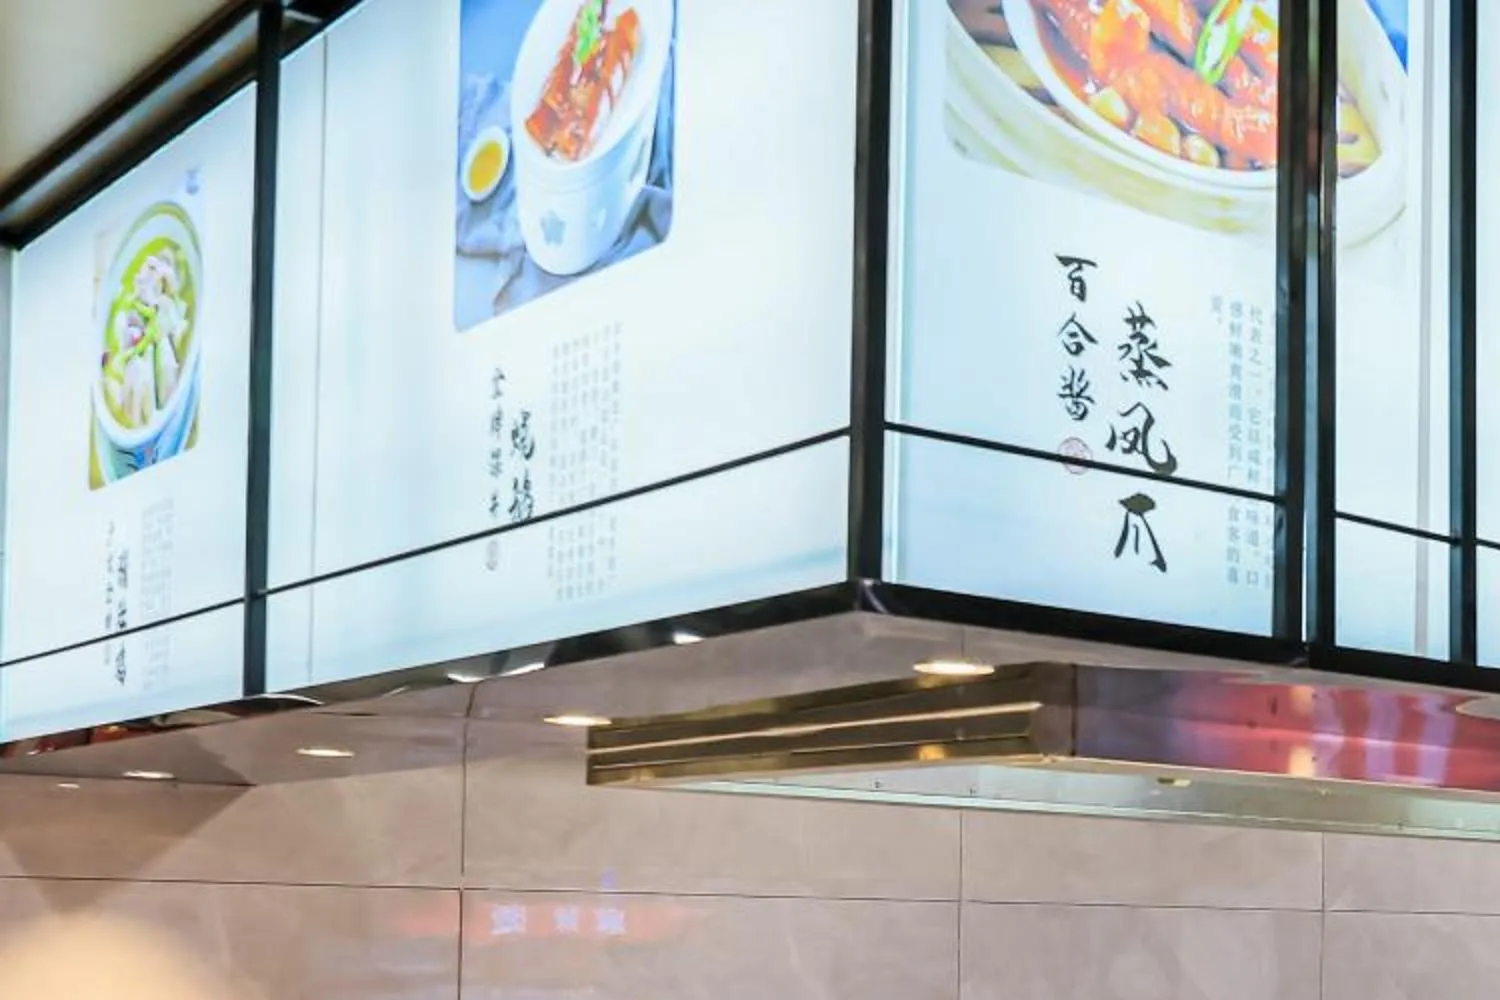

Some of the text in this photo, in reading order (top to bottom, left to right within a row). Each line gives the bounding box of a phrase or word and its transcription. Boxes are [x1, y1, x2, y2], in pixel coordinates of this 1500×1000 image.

[1055, 253, 1098, 422] 百合酱
[1105, 300, 1178, 574] 蒸凤爪
